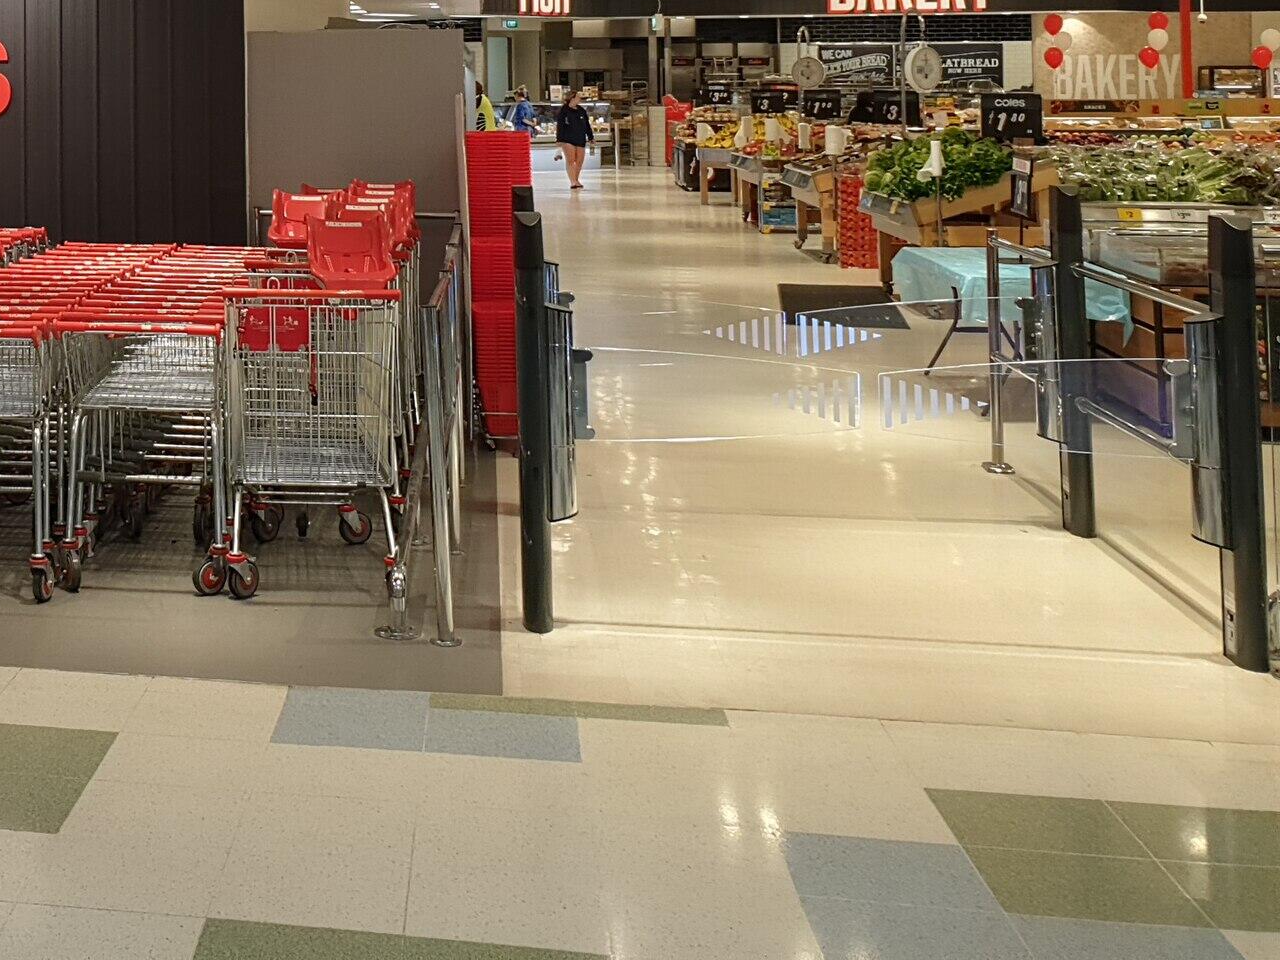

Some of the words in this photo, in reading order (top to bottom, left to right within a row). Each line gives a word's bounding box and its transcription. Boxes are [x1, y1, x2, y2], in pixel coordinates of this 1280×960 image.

[821, 49, 835, 60] WE
[835, 49, 852, 60] CAN
[861, 55, 888, 68] BREAD
[940, 58, 999, 68] ATBREAD
[1053, 53, 1181, 100] BAKERY
[994, 97, 1026, 108] coles
